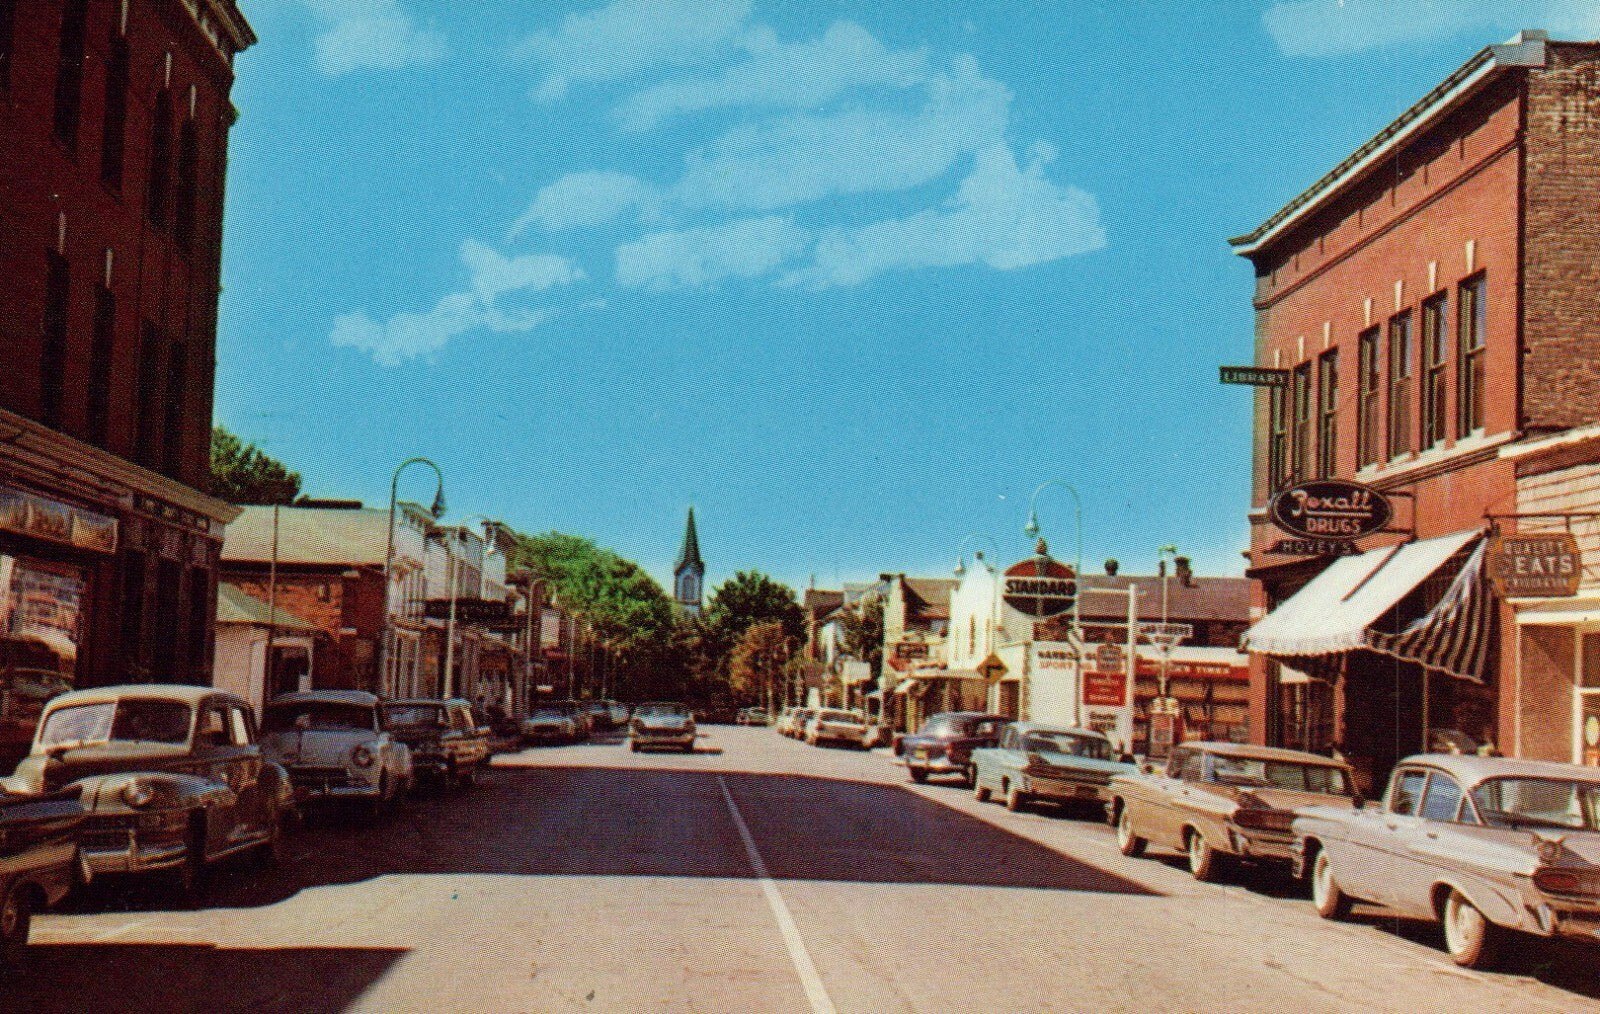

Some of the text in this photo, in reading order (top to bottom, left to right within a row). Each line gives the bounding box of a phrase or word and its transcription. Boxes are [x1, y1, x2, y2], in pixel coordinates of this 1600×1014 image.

[1223, 370, 1284, 384] LIBRARY
[1290, 488, 1373, 517] Rexall
[1305, 517, 1362, 534] DRUGS
[1006, 580, 1076, 596] STANDARD
